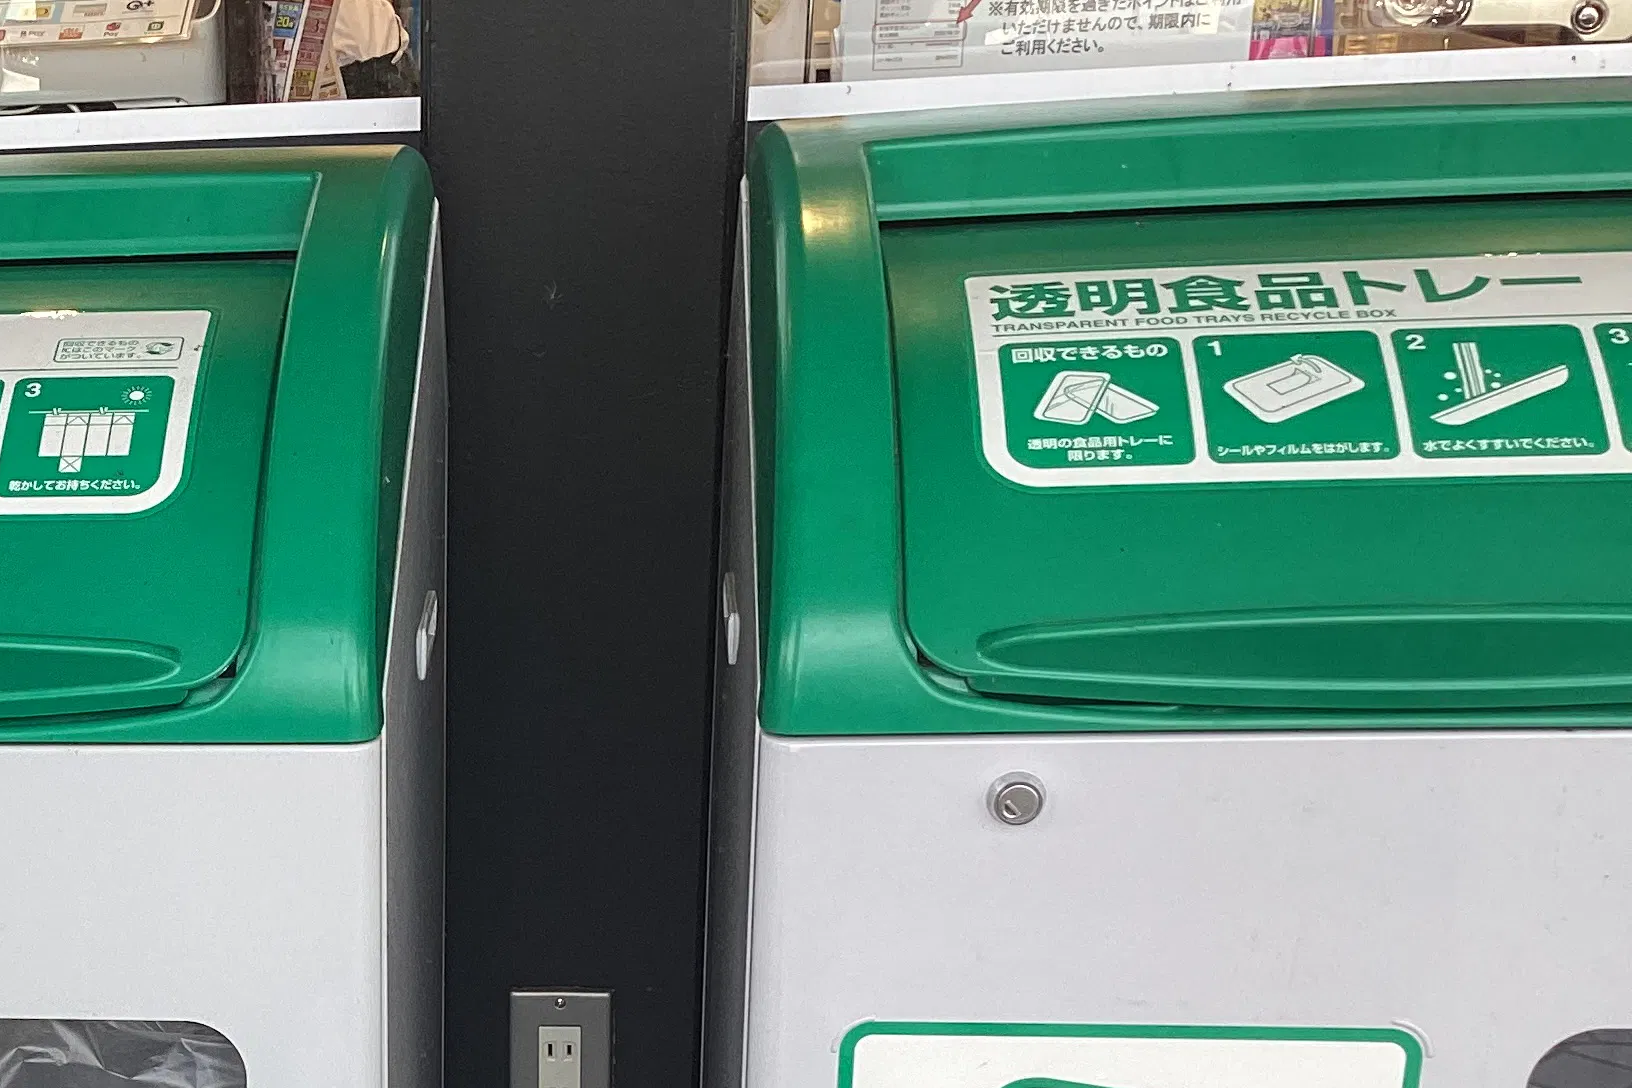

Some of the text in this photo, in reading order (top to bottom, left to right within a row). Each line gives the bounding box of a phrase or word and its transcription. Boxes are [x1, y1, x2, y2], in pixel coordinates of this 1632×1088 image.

[1002, 12, 1211, 35] いただけませんので、期限内に
[1001, 38, 1104, 56] ご利用ください。
[989, 268, 1583, 321] 透明食品トレー
[992, 308, 1398, 333] TRANSPARENT FOOD TRAYS RECYCLE BOX
[1405, 333, 1427, 350] 2
[1608, 327, 1630, 344] 3
[1011, 343, 1168, 364] 回収できるもの
[1207, 340, 1222, 356] 1
[24, 382, 42, 398] 3
[1027, 434, 1174, 450] 透明の食品用トレーに
[1217, 441, 1390, 457] シールやフィルムをはがします。
[1423, 437, 1595, 453] 水でよくすすいでください。
[1068, 449, 1133, 462] 限ります。
[8, 479, 141, 492] 乾かしてお持ちください。
